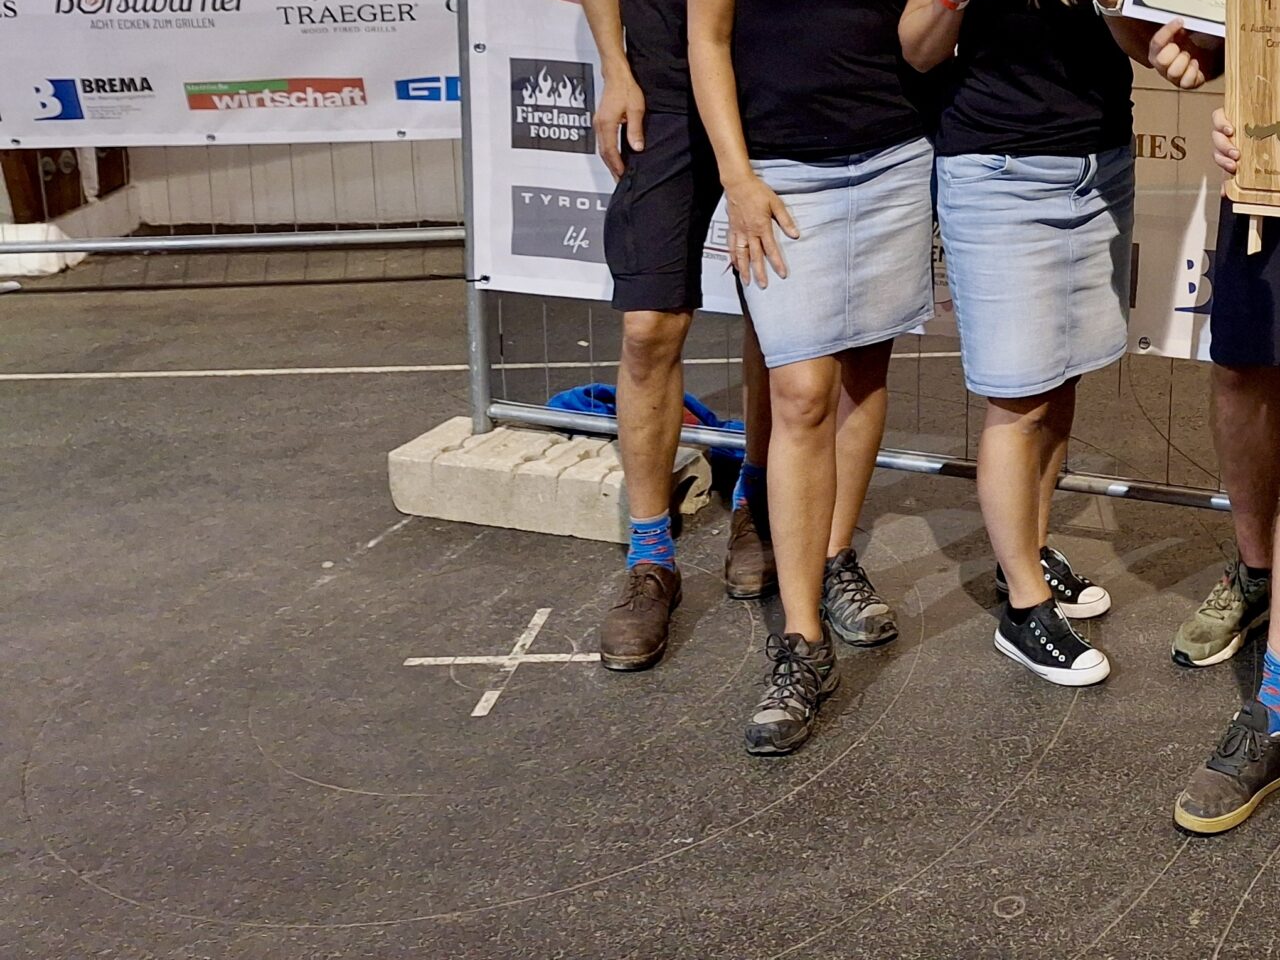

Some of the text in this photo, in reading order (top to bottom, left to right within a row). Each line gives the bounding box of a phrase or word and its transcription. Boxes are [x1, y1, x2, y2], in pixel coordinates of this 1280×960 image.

[90, 17, 216, 30] ACHT ECKEN ZUM GRILLEN
[276, 3, 417, 25] TRAEGER
[81, 77, 154, 94] BREMA
[211, 86, 365, 110] wirtschaft
[516, 105, 591, 128] Fireland
[530, 124, 579, 141] FOODS
[563, 225, 590, 254] life
